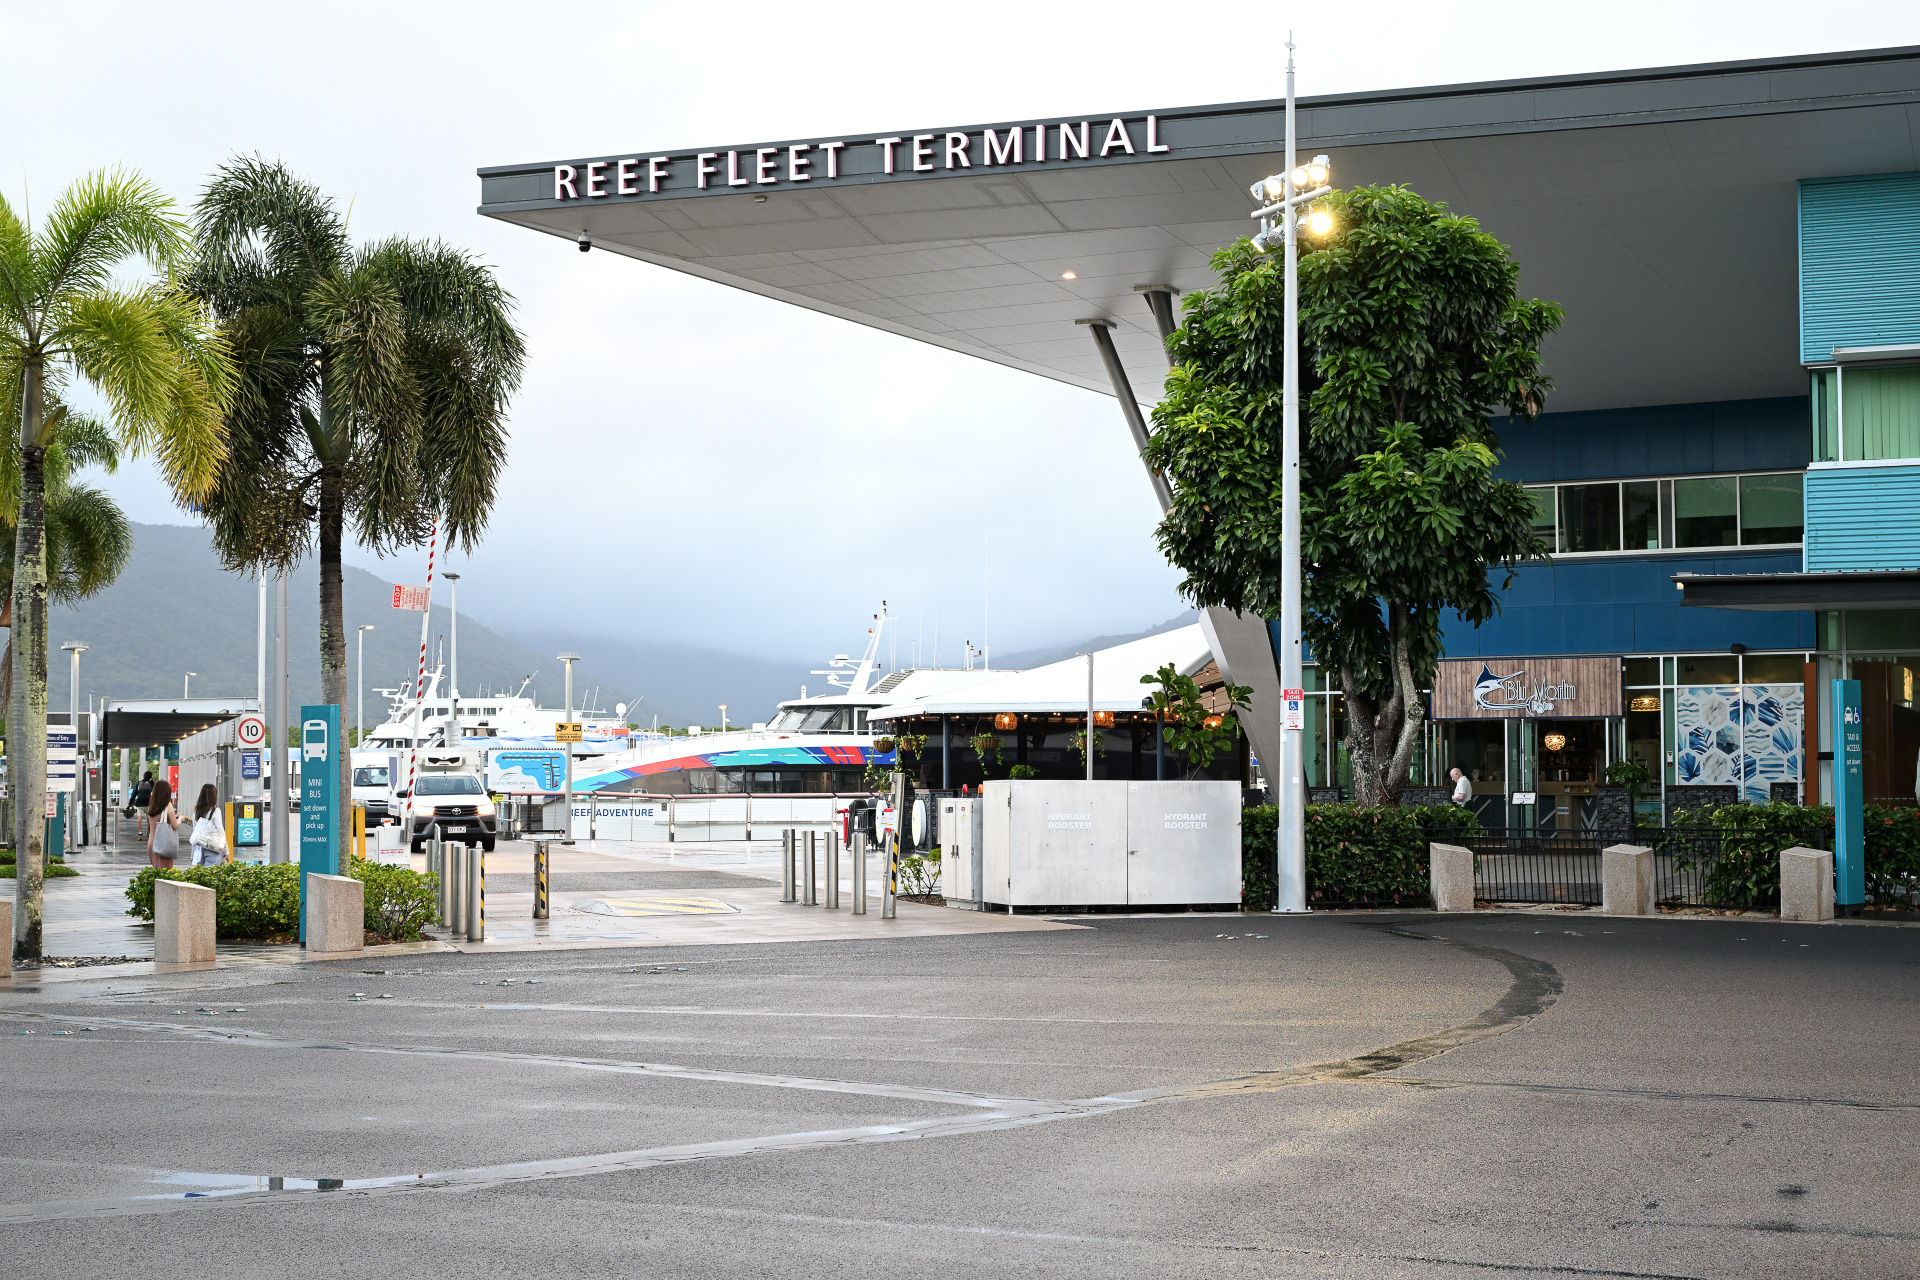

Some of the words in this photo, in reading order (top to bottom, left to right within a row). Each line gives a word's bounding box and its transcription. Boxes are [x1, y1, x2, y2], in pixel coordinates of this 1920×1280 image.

[554, 156, 669, 200] REEF
[697, 141, 845, 189] FLEET
[875, 115, 1170, 174] TERMINAL
[1505, 680, 1527, 701] Blu
[1534, 678, 1576, 702] Marlin
[246, 725, 258, 736] 10
[61, 734, 69, 742] Entry
[1846, 744, 1860, 752] ACCESS
[147, 750, 153, 760] 2
[308, 779, 323, 787] MINI
[309, 790, 321, 798] BUS
[312, 804, 327, 812] down
[595, 808, 654, 817] ADVENTURE
[310, 813, 320, 821] and
[1048, 813, 1092, 821] HYDRANT
[1164, 813, 1208, 821] HYDRANT
[305, 822, 316, 831] pick
